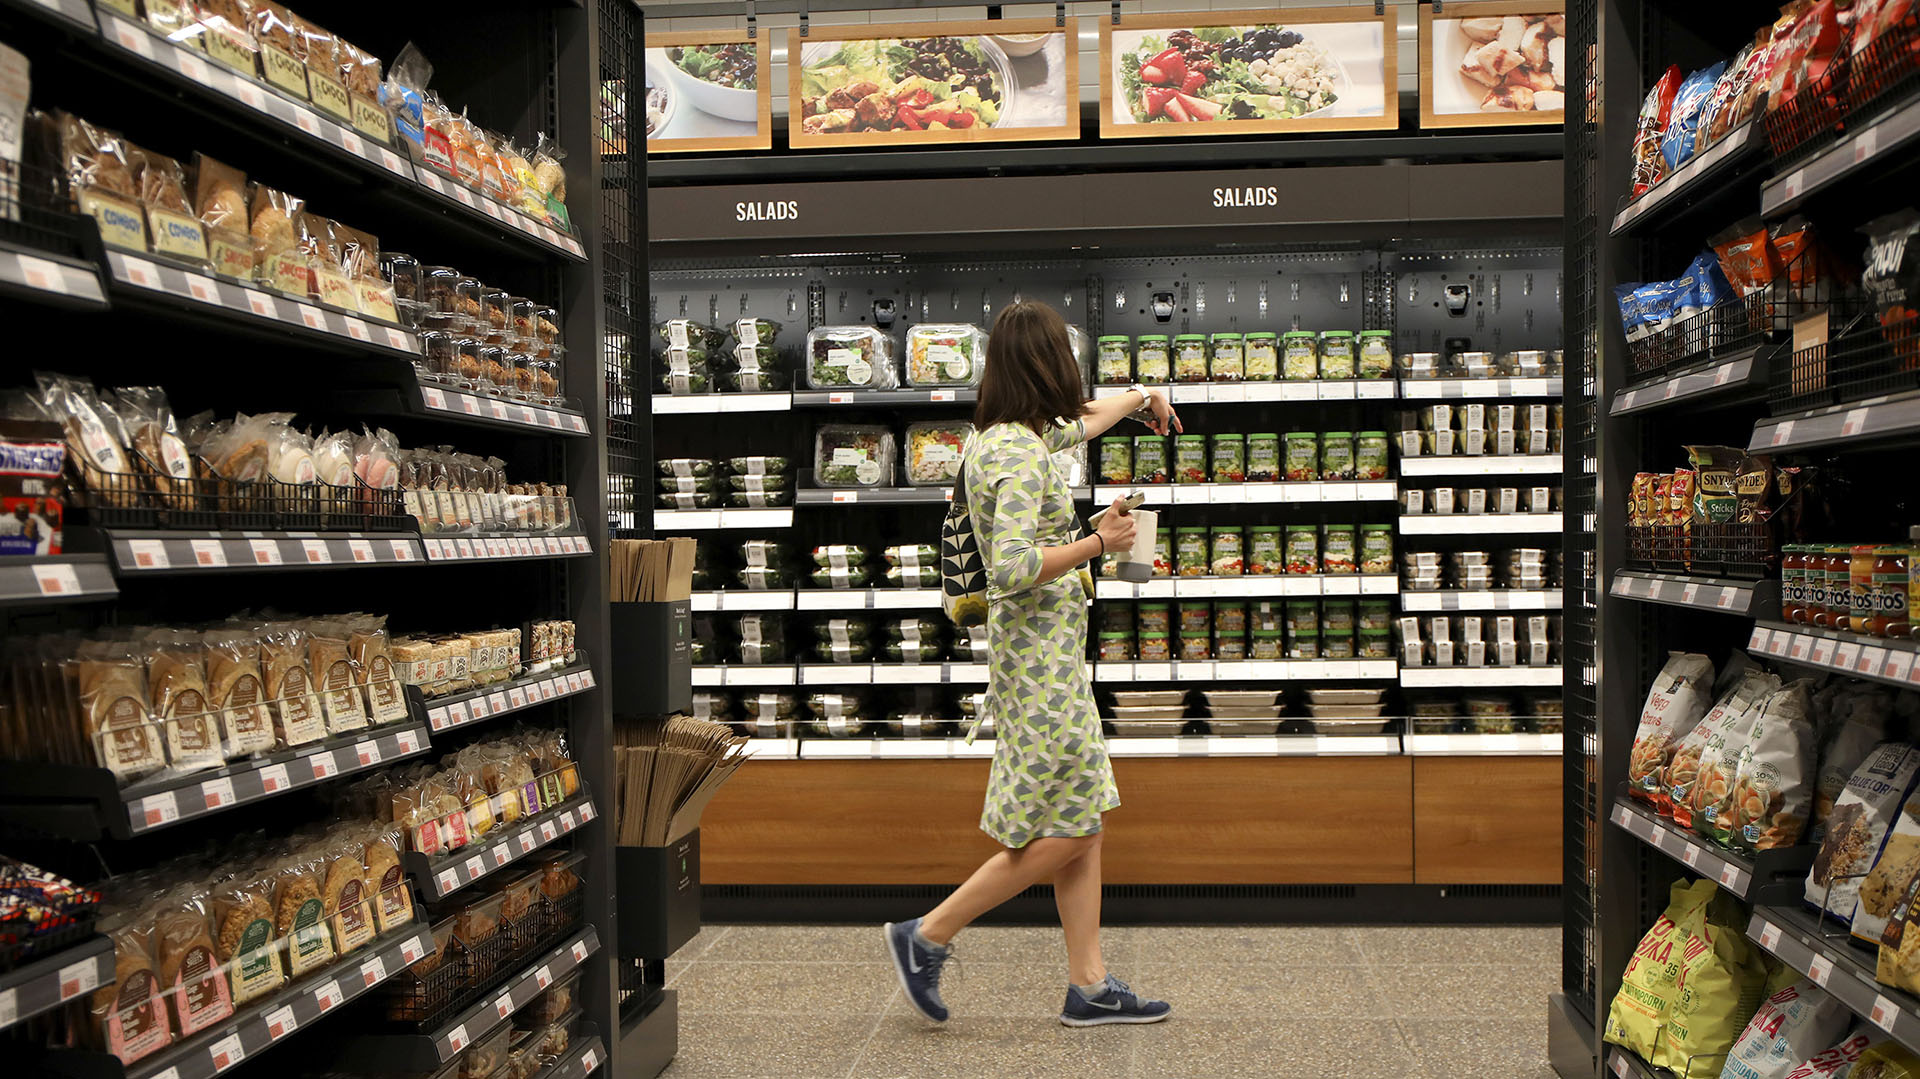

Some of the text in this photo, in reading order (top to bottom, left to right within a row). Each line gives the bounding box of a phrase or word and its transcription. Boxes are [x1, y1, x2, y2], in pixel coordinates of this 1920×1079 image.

[275, 49, 304, 80] CHOCO
[320, 79, 348, 107] CHOCO
[362, 105, 387, 131] CHOCO
[1212, 186, 1278, 208] SALADS
[104, 207, 141, 235] COWBOY
[736, 200, 798, 222] SALADS
[168, 221, 200, 242] COWBOY
[1711, 502, 1735, 514] Sticks
[1755, 771, 1774, 781] 30%
[1665, 962, 1679, 977] 35
[1682, 988, 1691, 1003] 35
